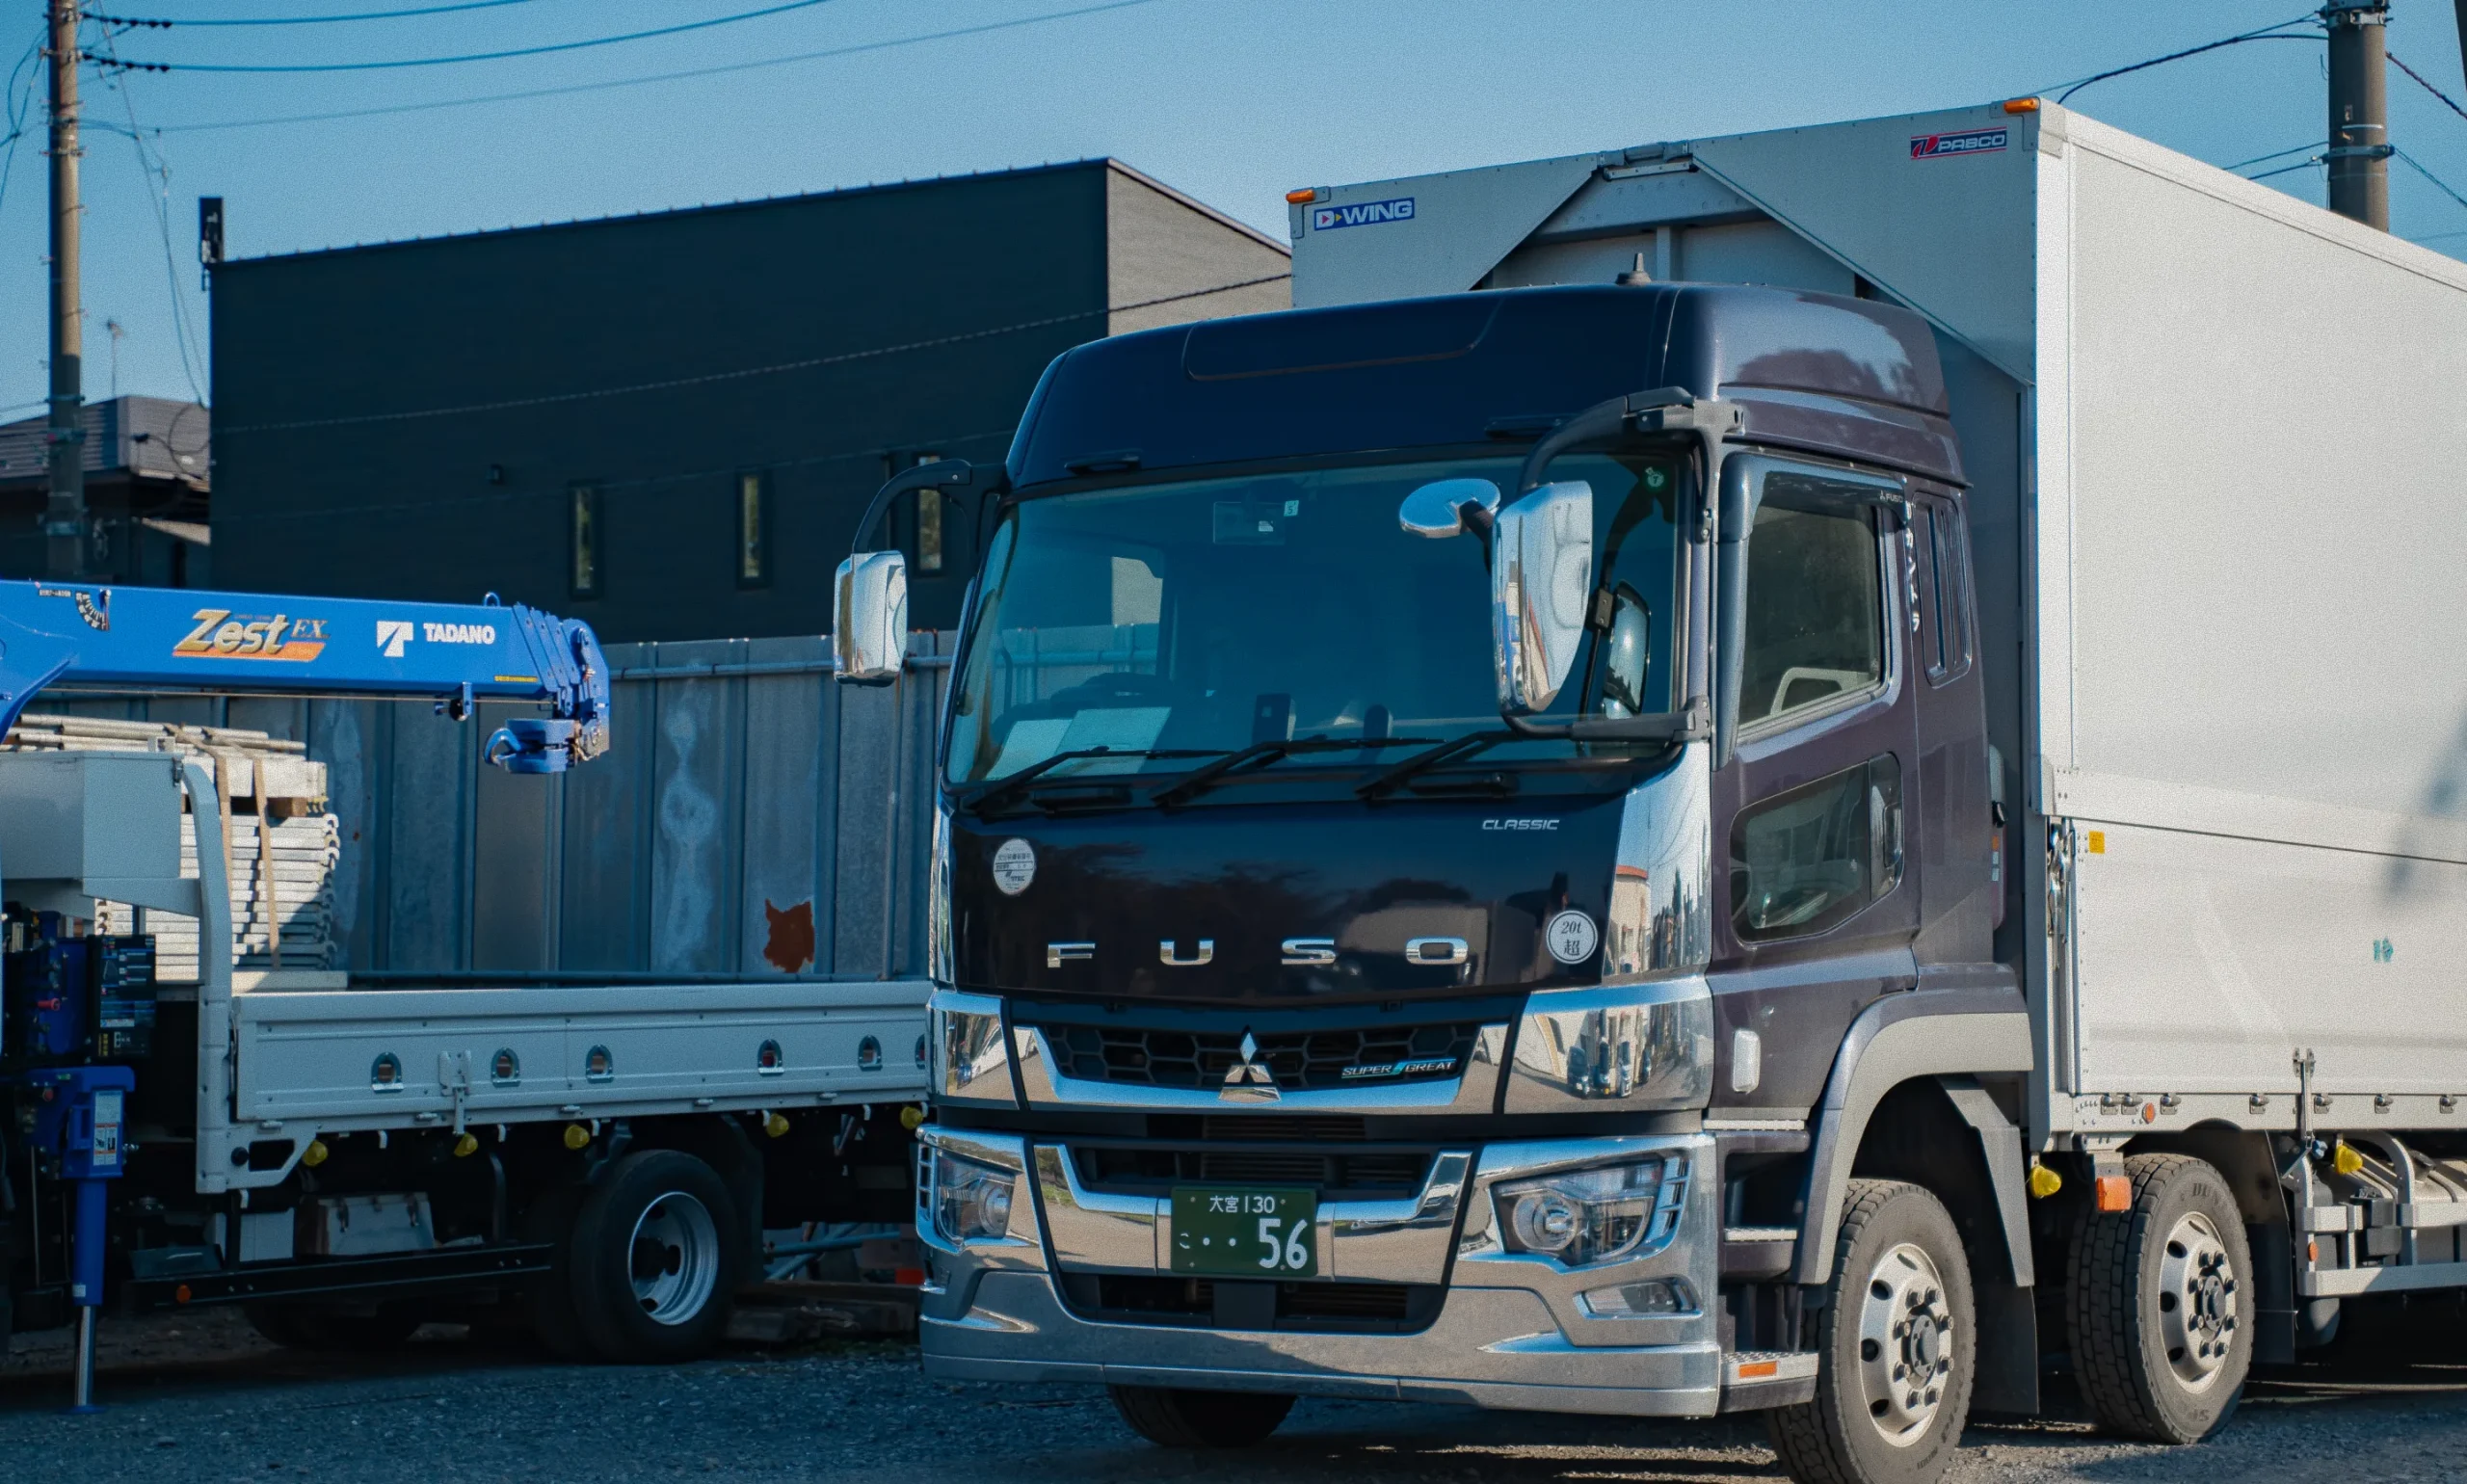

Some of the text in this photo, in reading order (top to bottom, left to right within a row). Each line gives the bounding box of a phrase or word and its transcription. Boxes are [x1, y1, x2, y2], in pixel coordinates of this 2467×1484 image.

[1938, 135, 2005, 152] PABCO
[1886, 492, 1903, 503] FUSO
[173, 608, 330, 655] Zest EX
[422, 623, 495, 645] TADANO
[1482, 819, 1560, 831] CLASSIC
[1561, 920, 1582, 934] 20t
[1048, 938, 1470, 967] FUSO
[1341, 1061, 1454, 1076] SUPER GREAT
